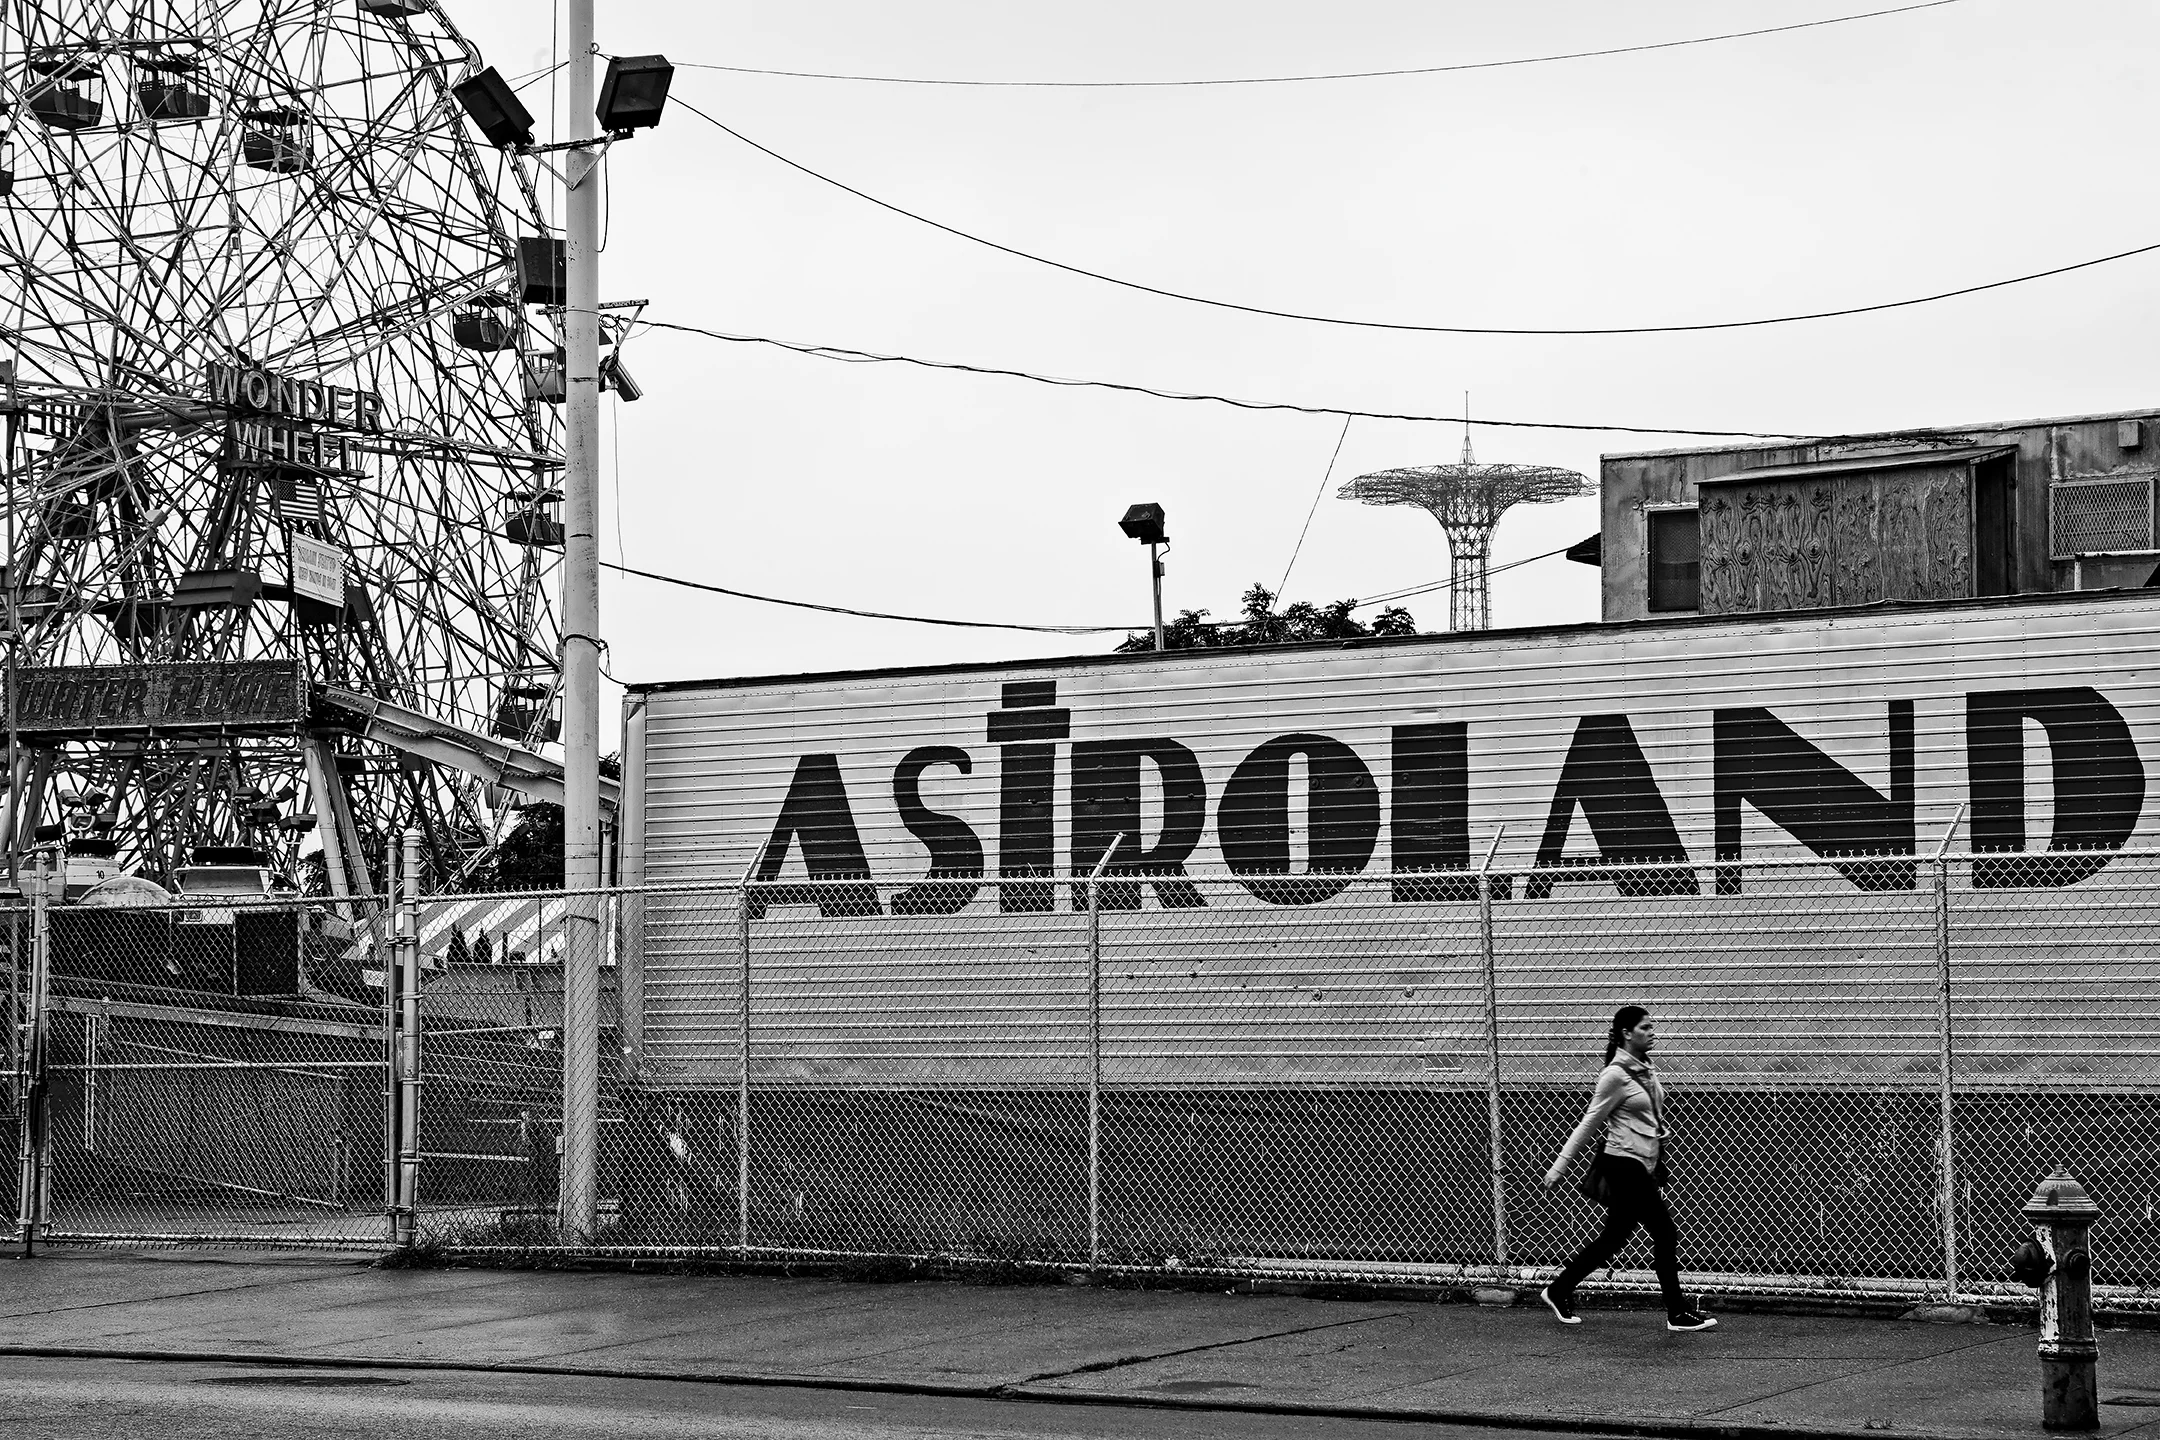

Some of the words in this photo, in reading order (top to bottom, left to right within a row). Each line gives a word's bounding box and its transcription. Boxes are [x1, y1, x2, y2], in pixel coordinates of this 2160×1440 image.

[207, 361, 383, 432] WONDER
[230, 420, 366, 478] WHEEL
[16, 679, 148, 720] WATER
[162, 673, 293, 716] FLUME
[747, 680, 2146, 920] ASTROLAND
[96, 870, 105, 879] 10
